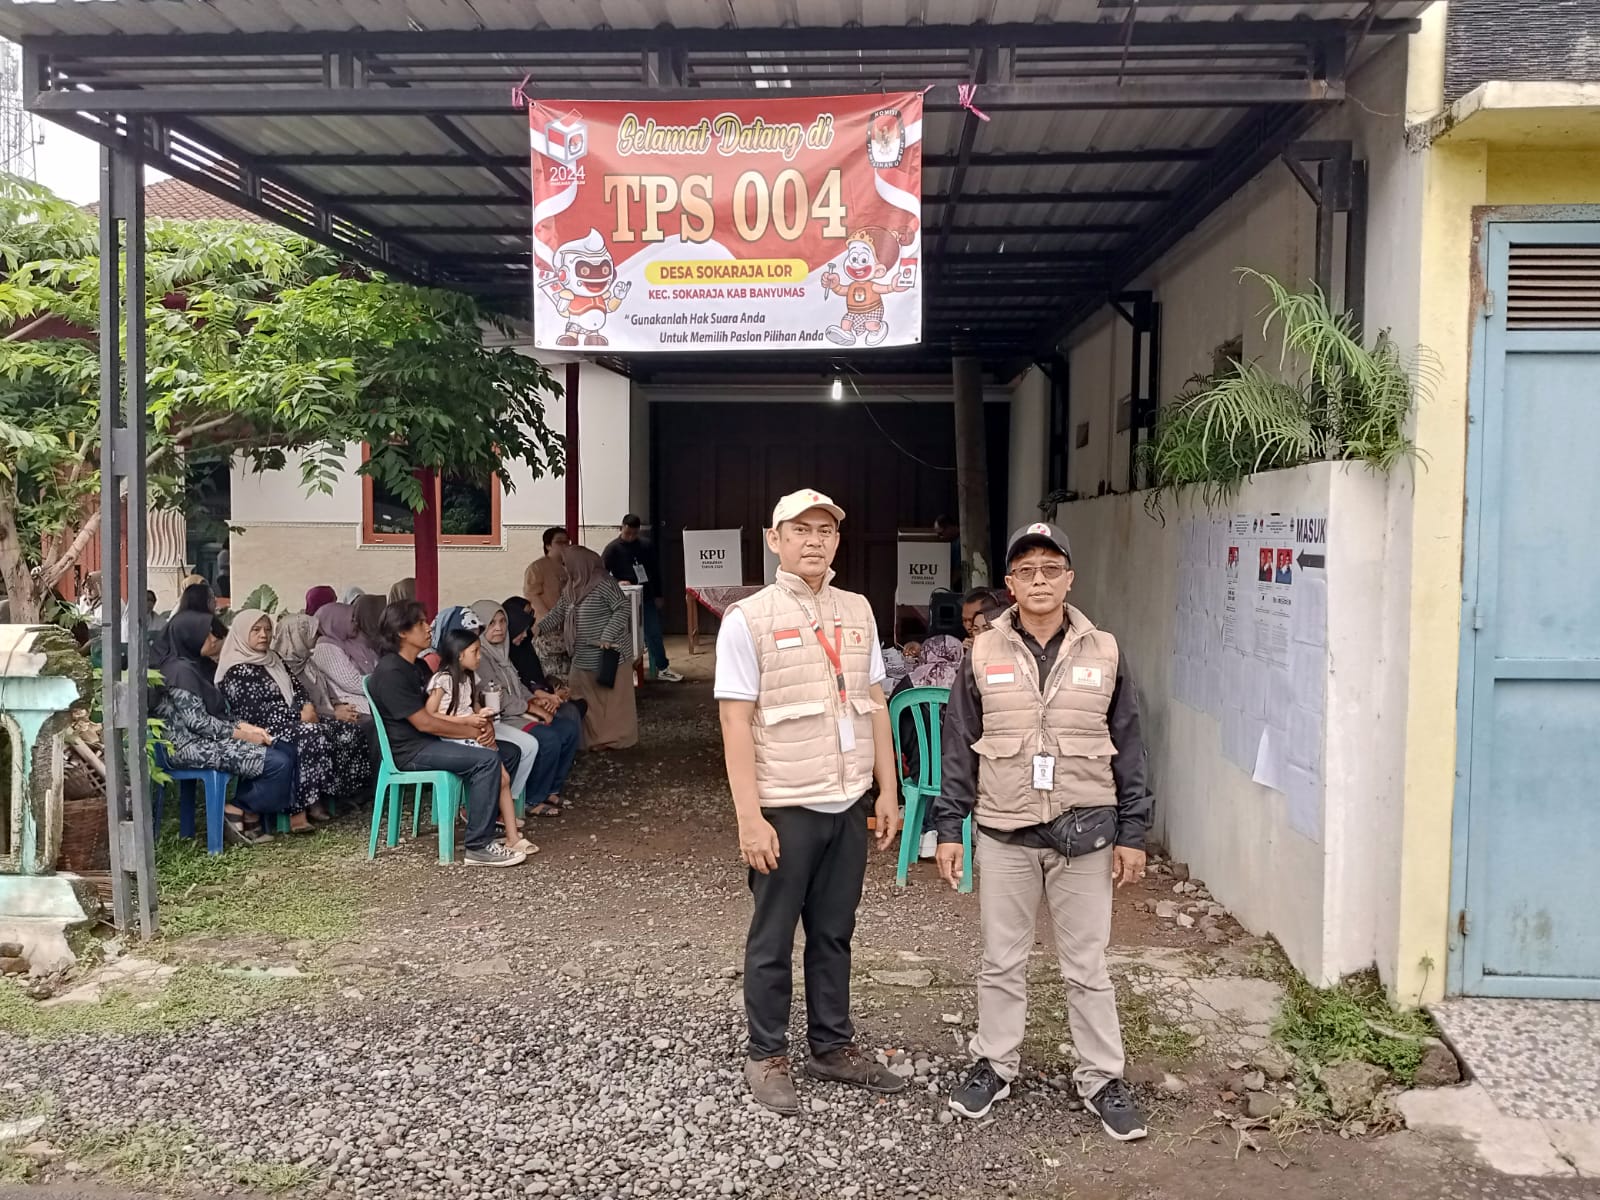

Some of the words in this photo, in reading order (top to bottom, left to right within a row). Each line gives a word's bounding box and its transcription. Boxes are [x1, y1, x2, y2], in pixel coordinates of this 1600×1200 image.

[618, 114, 711, 154] Selamat
[714, 114, 803, 158] Datang
[806, 115, 833, 149] di
[550, 165, 585, 181] 2024
[604, 174, 715, 244] TPS
[732, 168, 847, 242] 004
[660, 266, 692, 279] DESA
[696, 265, 763, 279] SOKARAJA
[767, 264, 793, 278] LOR
[648, 289, 670, 300] KEC.
[672, 288, 725, 299] SOKARAJA
[726, 288, 747, 299] KAB
[749, 287, 805, 298] BANYUMAS
[689, 313, 709, 324] Hak
[711, 313, 738, 324] Suara
[740, 313, 766, 323] Anda
[659, 331, 689, 343] Untuk
[690, 331, 728, 343] Memilih
[730, 331, 762, 342] Paslon
[763, 330, 797, 342] Pilihan
[799, 329, 824, 341] Anda
[1296, 518, 1326, 544] MASUK
[700, 549, 726, 560] KPU
[909, 563, 938, 575] KPU
